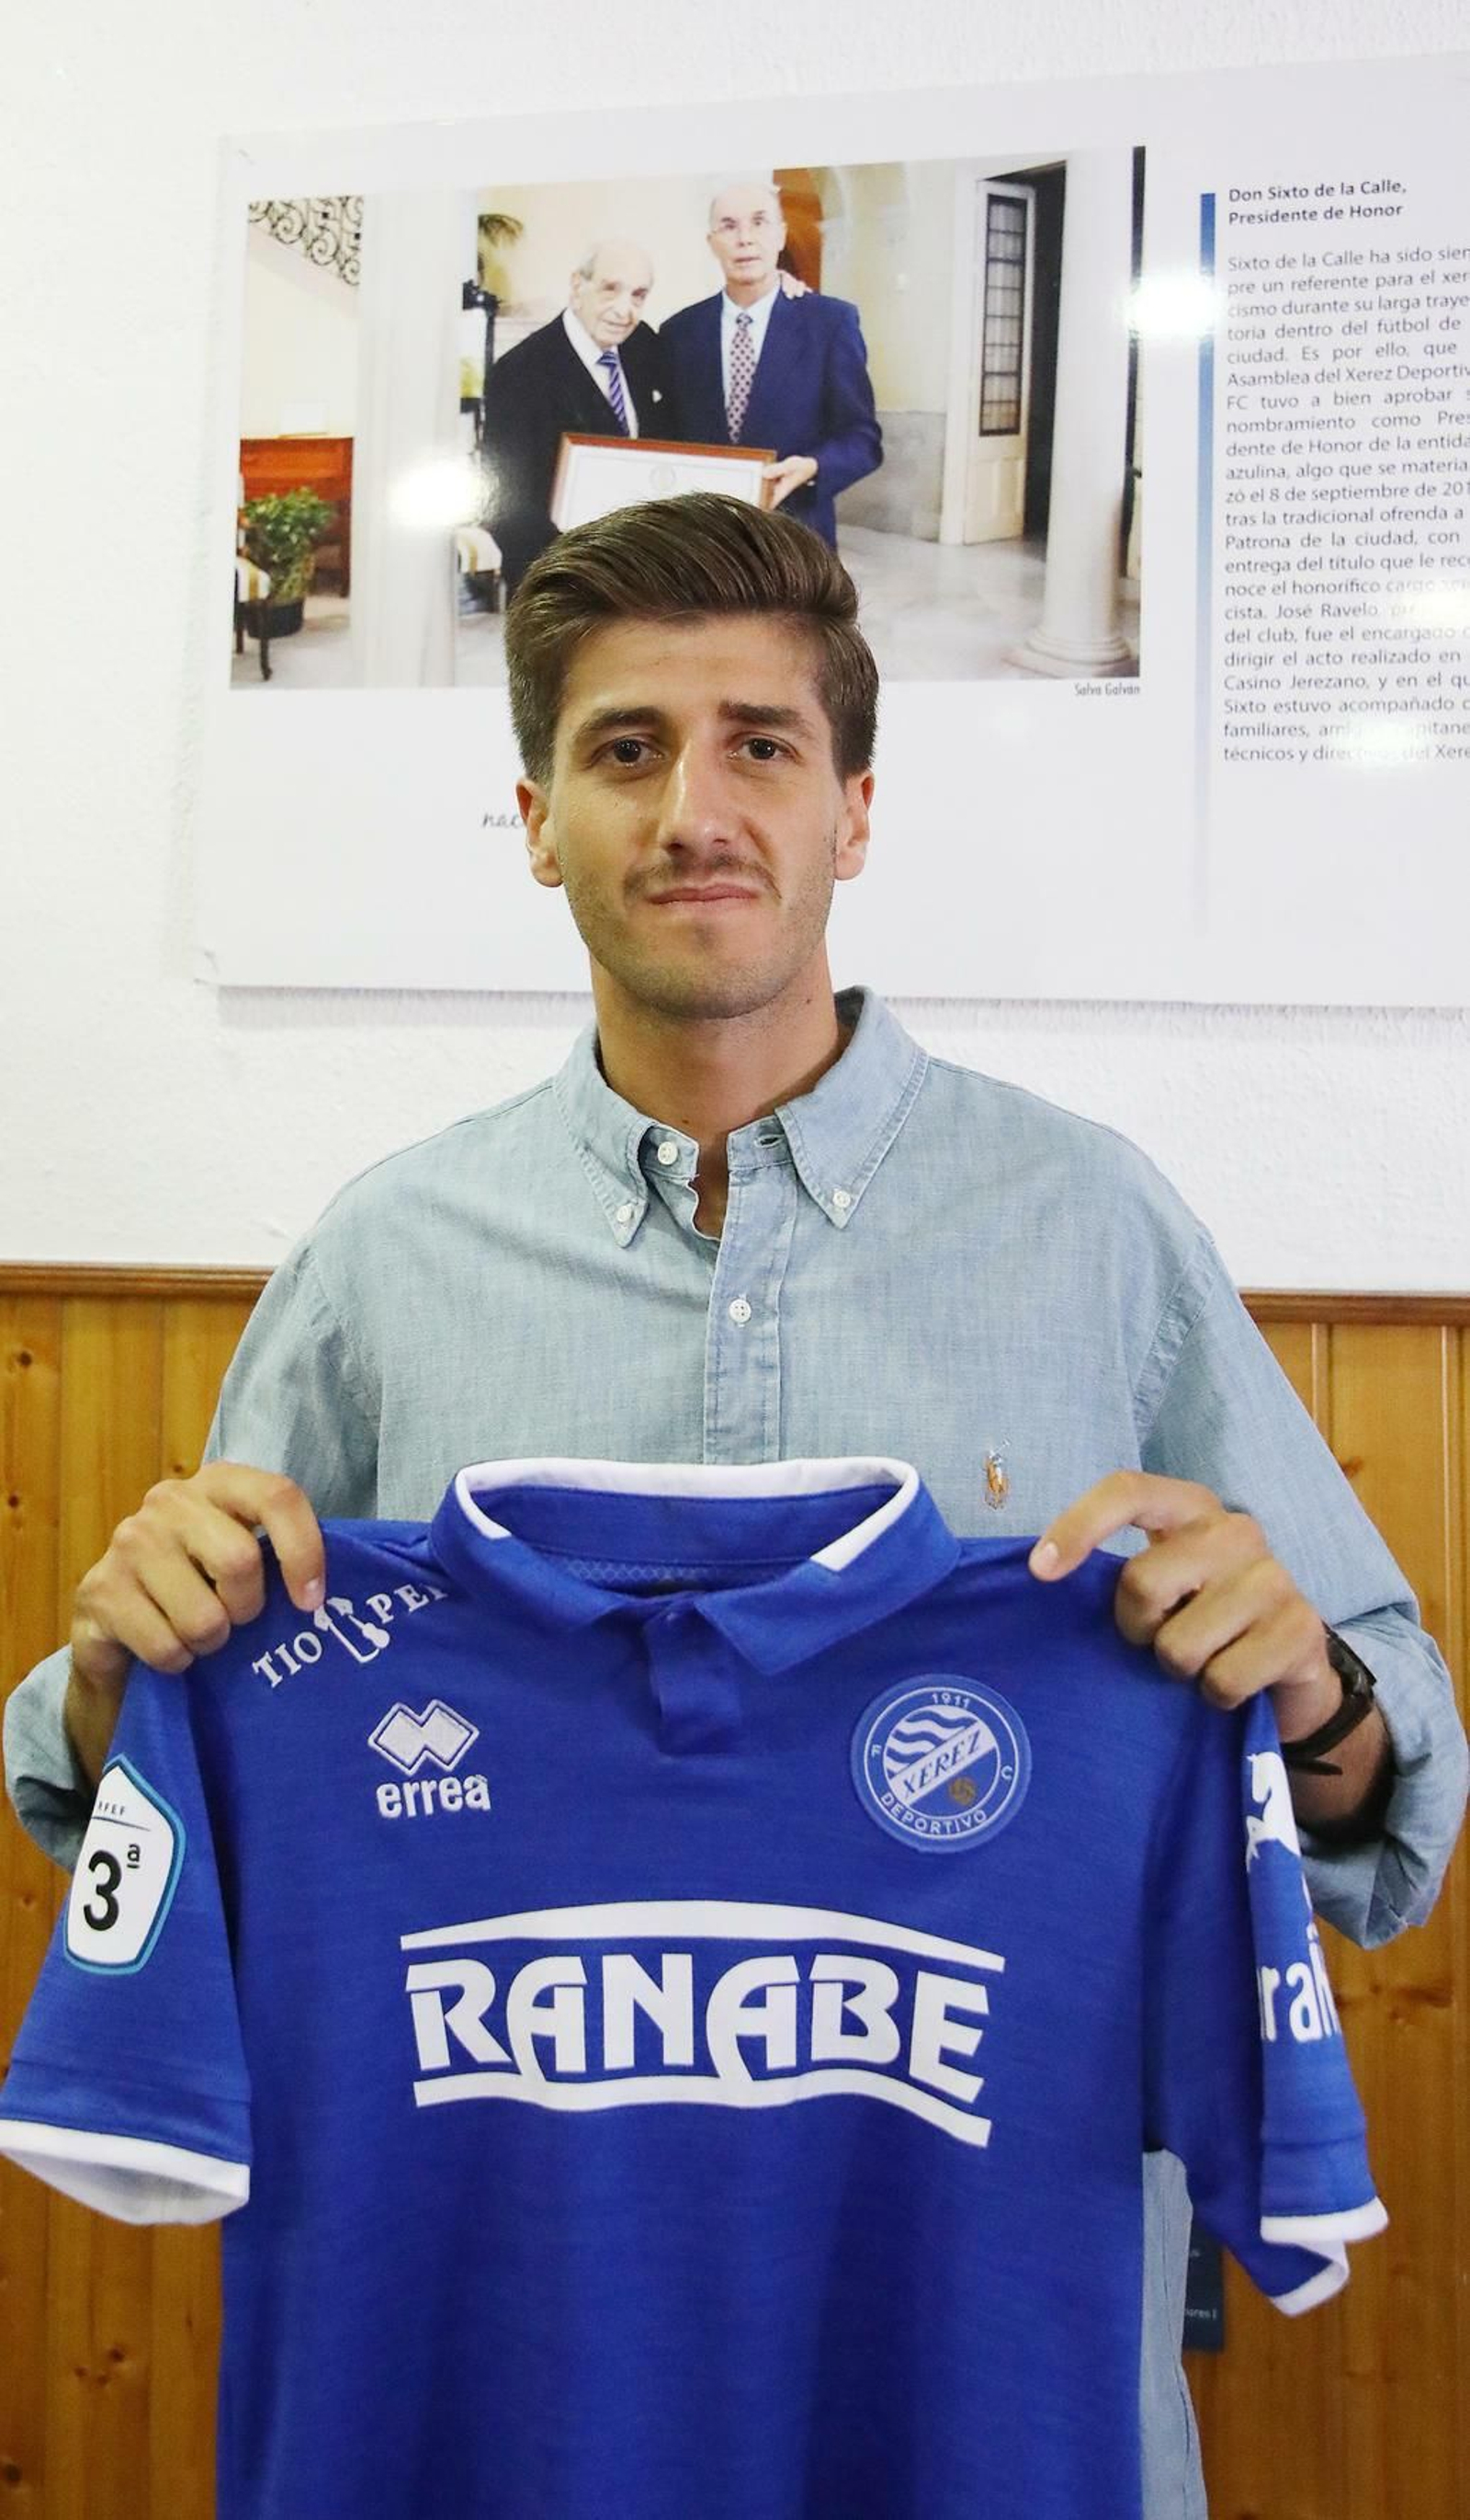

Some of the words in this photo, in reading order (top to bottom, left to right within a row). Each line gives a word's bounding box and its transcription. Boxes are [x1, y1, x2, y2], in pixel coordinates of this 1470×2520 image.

[1229, 188, 1262, 202] Don
[1267, 186, 1309, 200] Sixto
[1314, 183, 1335, 198] de
[1340, 182, 1355, 197] la
[1360, 179, 1407, 195] Calle,
[1229, 209, 1318, 226] Presidente
[1323, 206, 1344, 221] de
[1350, 204, 1404, 219] Honor
[1228, 256, 1270, 271] Sixto
[1275, 255, 1297, 269] de
[1303, 254, 1317, 268] la
[1322, 251, 1363, 267] Calle
[1370, 250, 1392, 265] ha
[1396, 247, 1432, 263] sido
[1227, 283, 1256, 299] pre
[1262, 281, 1283, 293] un
[1291, 276, 1369, 291] referente
[1375, 275, 1413, 291] para
[1419, 270, 1435, 285] el
[1227, 303, 1277, 318] cismo
[1282, 300, 1350, 315] durante
[1354, 301, 1373, 312] su
[1378, 296, 1420, 313] larga
[1227, 326, 1265, 341] toria
[1274, 324, 1333, 339] dentro
[1341, 320, 1368, 335] del
[1439, 316, 1462, 331] de
[1302, 346, 1319, 361] Es
[1332, 347, 1363, 363] por
[1423, 344, 1457, 359] que
[1227, 370, 1310, 387] Asamblea
[1314, 369, 1340, 384] del
[1346, 368, 1393, 382] Xerez
[1227, 395, 1248, 411] FC
[1261, 396, 1299, 409] tuvo
[1311, 396, 1320, 407] a
[1333, 392, 1371, 406] bien
[1384, 388, 1453, 407] aprobar
[1227, 416, 1355, 434] nombramiento
[1372, 415, 1421, 428] como
[1226, 442, 1275, 457] dente
[1281, 440, 1303, 455] de
[1309, 439, 1363, 454] Honor
[1369, 437, 1391, 451] de
[1396, 436, 1410, 450] la
[1296, 463, 1333, 481] algo
[1339, 464, 1373, 480] que
[1378, 463, 1396, 475] se
[1250, 488, 1265, 503] el
[1269, 488, 1280, 503] 8
[1284, 487, 1306, 502] de
[1312, 483, 1409, 504] septiembre
[1414, 482, 1437, 497] de
[1226, 514, 1257, 527] tras
[1262, 511, 1276, 526] la
[1283, 507, 1374, 525] tradicional
[1380, 505, 1448, 522] ofrenda
[1453, 508, 1464, 519] a
[1226, 535, 1291, 550] Patrona
[1300, 533, 1322, 548] de
[1331, 532, 1345, 547] la
[1428, 533, 1461, 545] con
[1225, 561, 1291, 576] entrega
[1296, 557, 1322, 572] del
[1380, 558, 1414, 573] que
[1419, 553, 1434, 568] le
[1225, 585, 1266, 596] noce
[1272, 581, 1286, 596] el
[1275, 604, 1313, 619] José
[1225, 629, 1250, 643] del
[1306, 628, 1333, 642] fue
[1340, 627, 1353, 641] el
[1362, 625, 1456, 643] encargado
[1224, 653, 1274, 670] dirigir
[1283, 651, 1297, 666] el
[1306, 653, 1343, 665] acto
[1351, 649, 1430, 664] realizado
[1439, 652, 1461, 663] en
[1224, 676, 1281, 691] Casino
[1378, 677, 1387, 692] y
[1396, 676, 1418, 687] en
[1427, 673, 1442, 687] el
[1224, 699, 1266, 714] Sixto
[1273, 700, 1331, 713] estuvo
[1339, 697, 1454, 715] acompañado
[1224, 746, 1295, 761] técnicos
[1299, 749, 1308, 764] y
[252, 1630, 322, 1688] TIO
[931, 1692, 971, 1708] 1911
[870, 1745, 882, 1758] F
[1000, 1765, 1013, 1781] C
[900, 1728, 983, 1798] XEREZ
[880, 1792, 989, 1835] DEPORTIVO
[405, 1953, 991, 2105] RANABE
